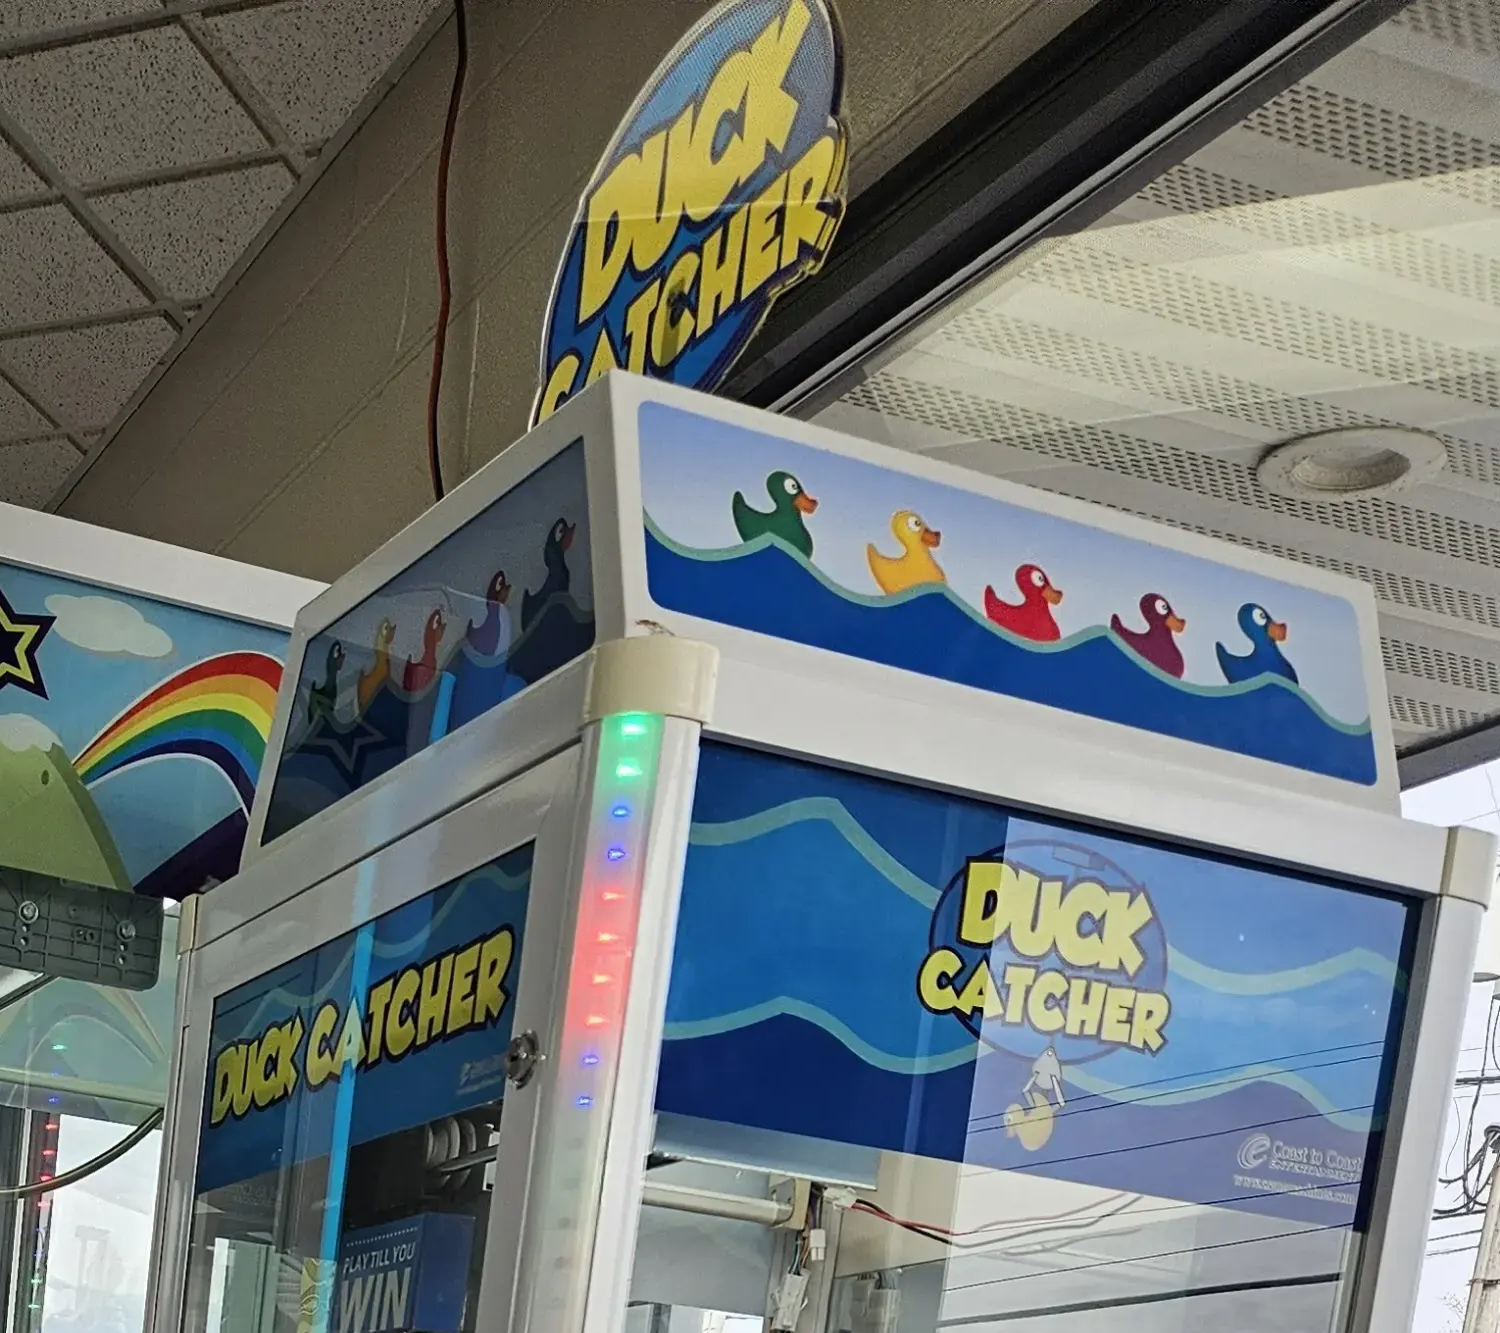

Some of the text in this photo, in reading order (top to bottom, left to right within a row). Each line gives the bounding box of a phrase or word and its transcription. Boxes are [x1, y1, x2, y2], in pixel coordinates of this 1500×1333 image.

[578, 0, 812, 324] DUCK
[959, 861, 1154, 977] DUCK
[210, 930, 514, 1125] DUCK CATCHER
[919, 949, 1170, 1052] CATCHER
[1271, 1140, 1363, 1173] Coast to Coast
[342, 1241, 416, 1275] PLAY TILL YOU
